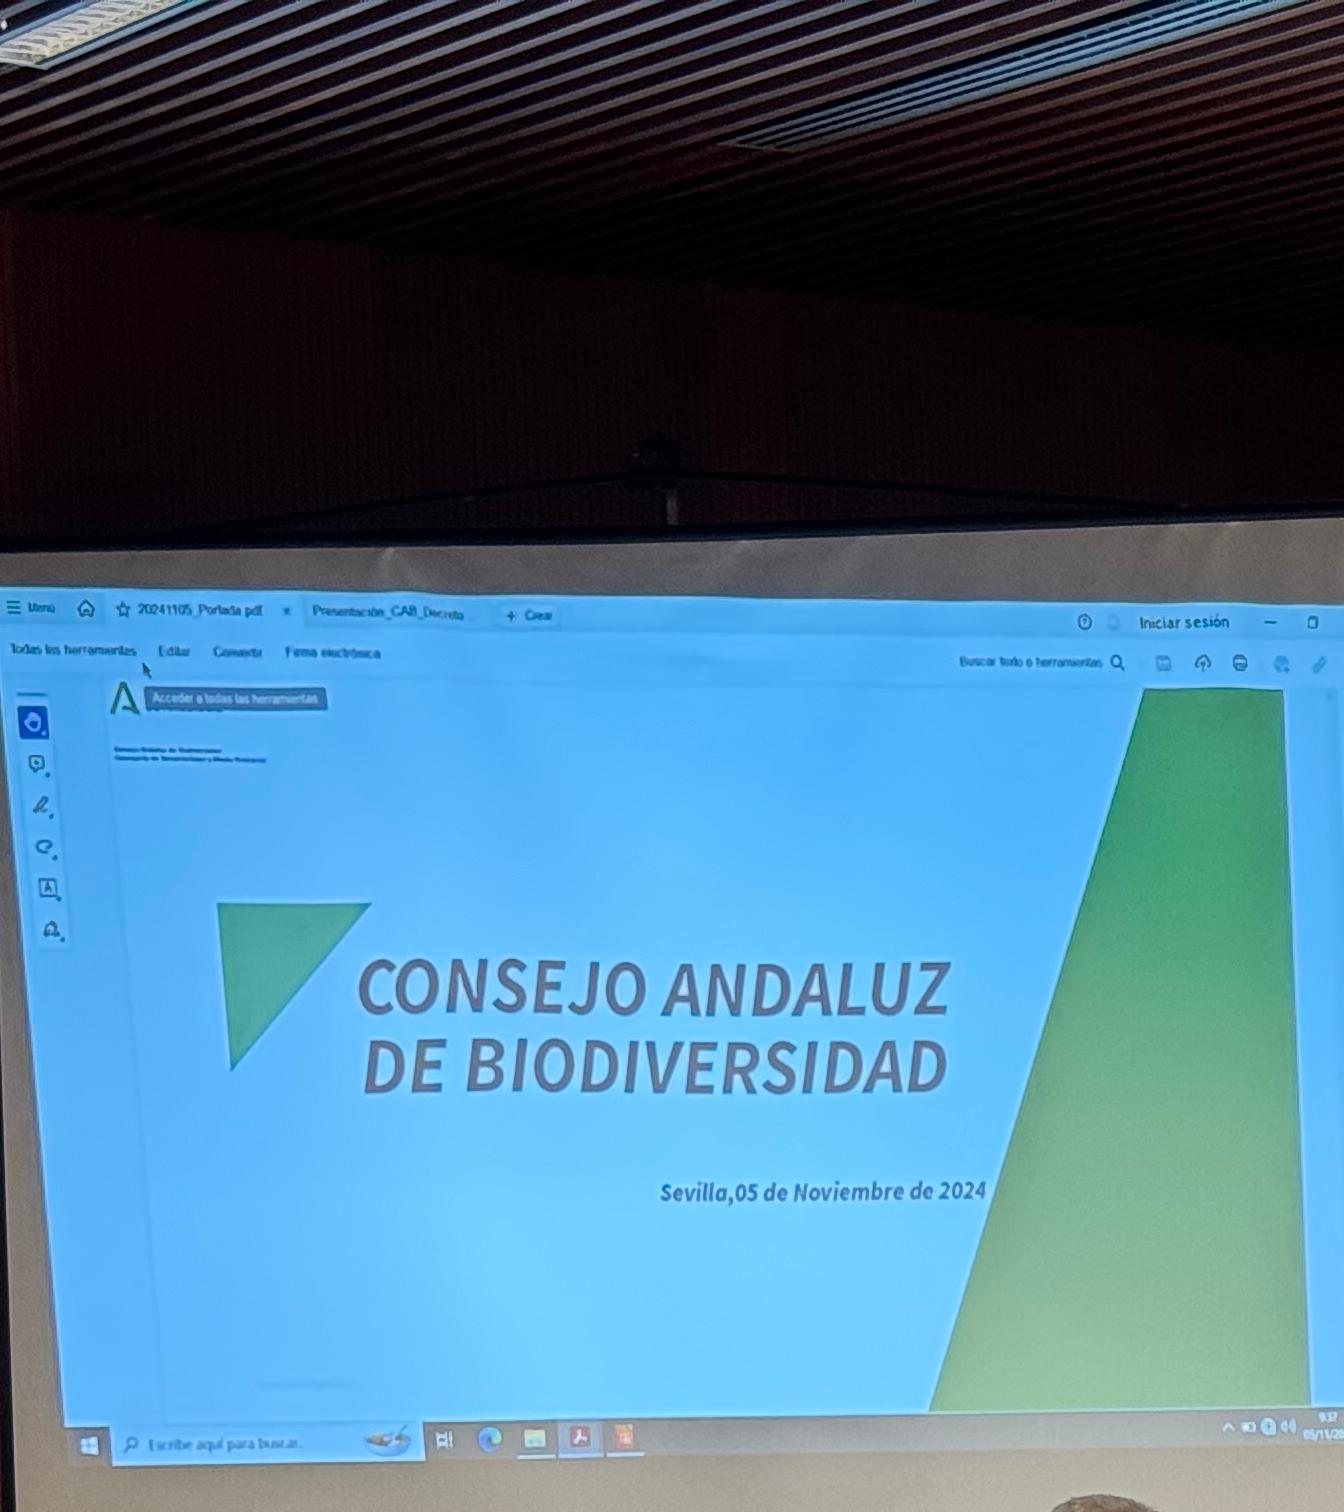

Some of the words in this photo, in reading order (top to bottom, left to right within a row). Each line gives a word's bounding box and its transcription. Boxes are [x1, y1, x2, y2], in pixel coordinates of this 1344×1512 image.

[1139, 615, 1181, 630] Iniciar
[1184, 613, 1230, 629] sesión
[64, 643, 137, 657] herramientas
[959, 655, 996, 668] Buscar
[1035, 656, 1103, 669] herramientas
[153, 691, 194, 704] Acceder
[252, 693, 319, 705] herramientas
[357, 957, 647, 1016] CONSEJO
[660, 960, 952, 1018] ANDALUZ
[363, 1038, 448, 1095] DE
[466, 1037, 948, 1096] BIODIVERSIDAD
[763, 1182, 788, 1202] de
[793, 1180, 906, 1202] Noviembre
[909, 1181, 934, 1201] de
[938, 1180, 987, 1200] 2024
[196, 1436, 224, 1454] aquí
[226, 1439, 255, 1454] para
